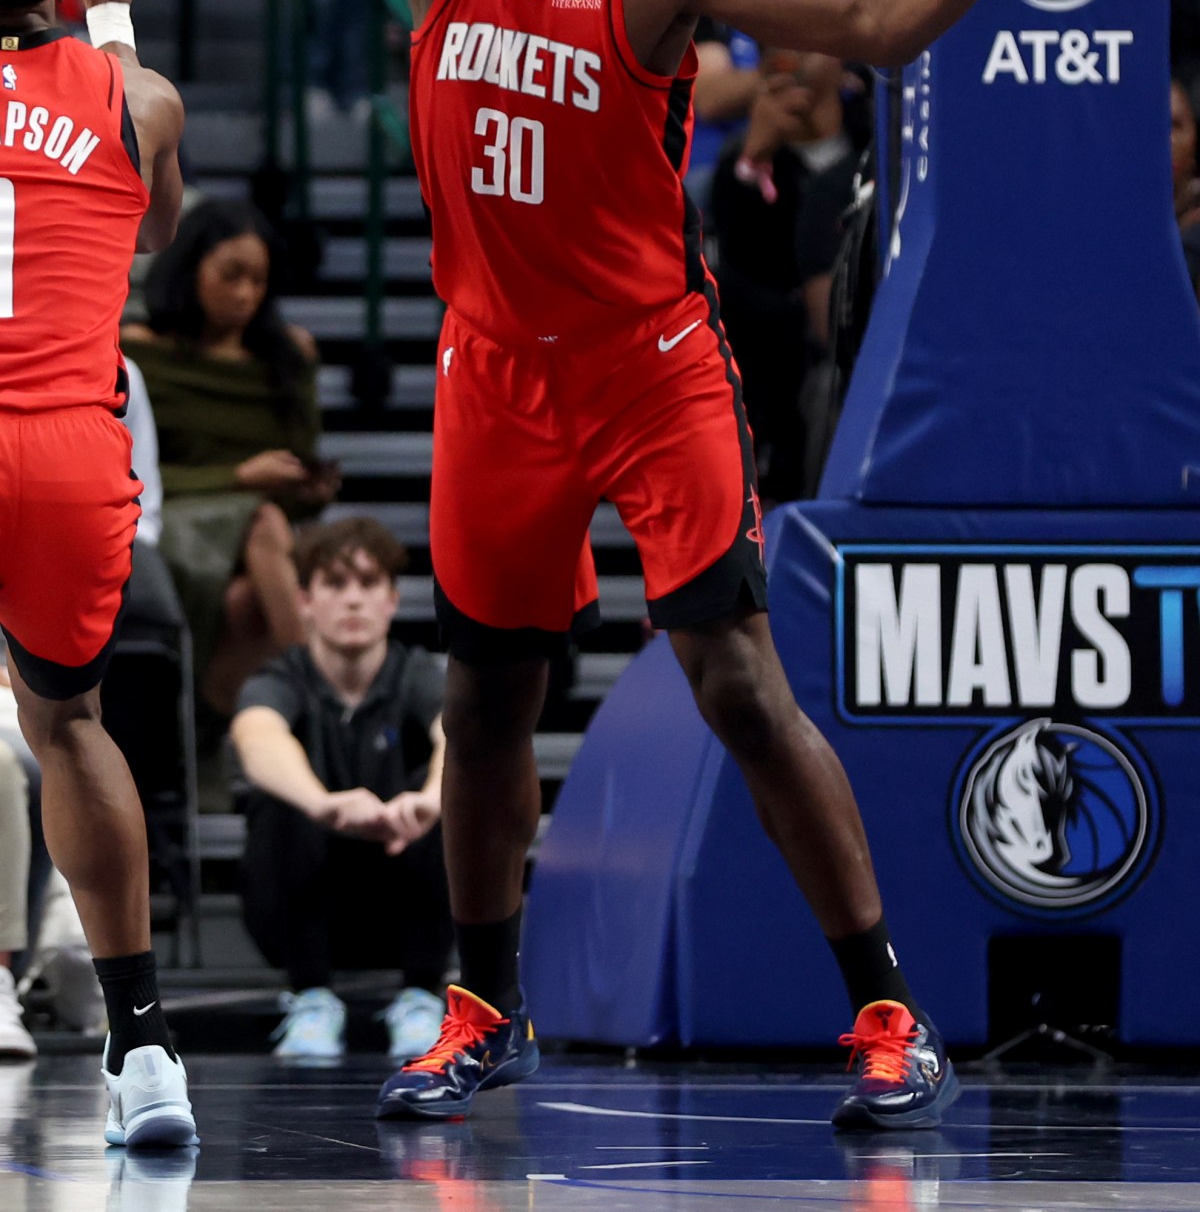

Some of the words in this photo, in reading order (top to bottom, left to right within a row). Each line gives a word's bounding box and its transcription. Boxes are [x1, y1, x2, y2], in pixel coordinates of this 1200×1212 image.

[982, 29, 1134, 85] AT&T
[471, 107, 544, 205] 30
[855, 563, 1132, 709] MAVS
[1133, 565, 1200, 708] T
